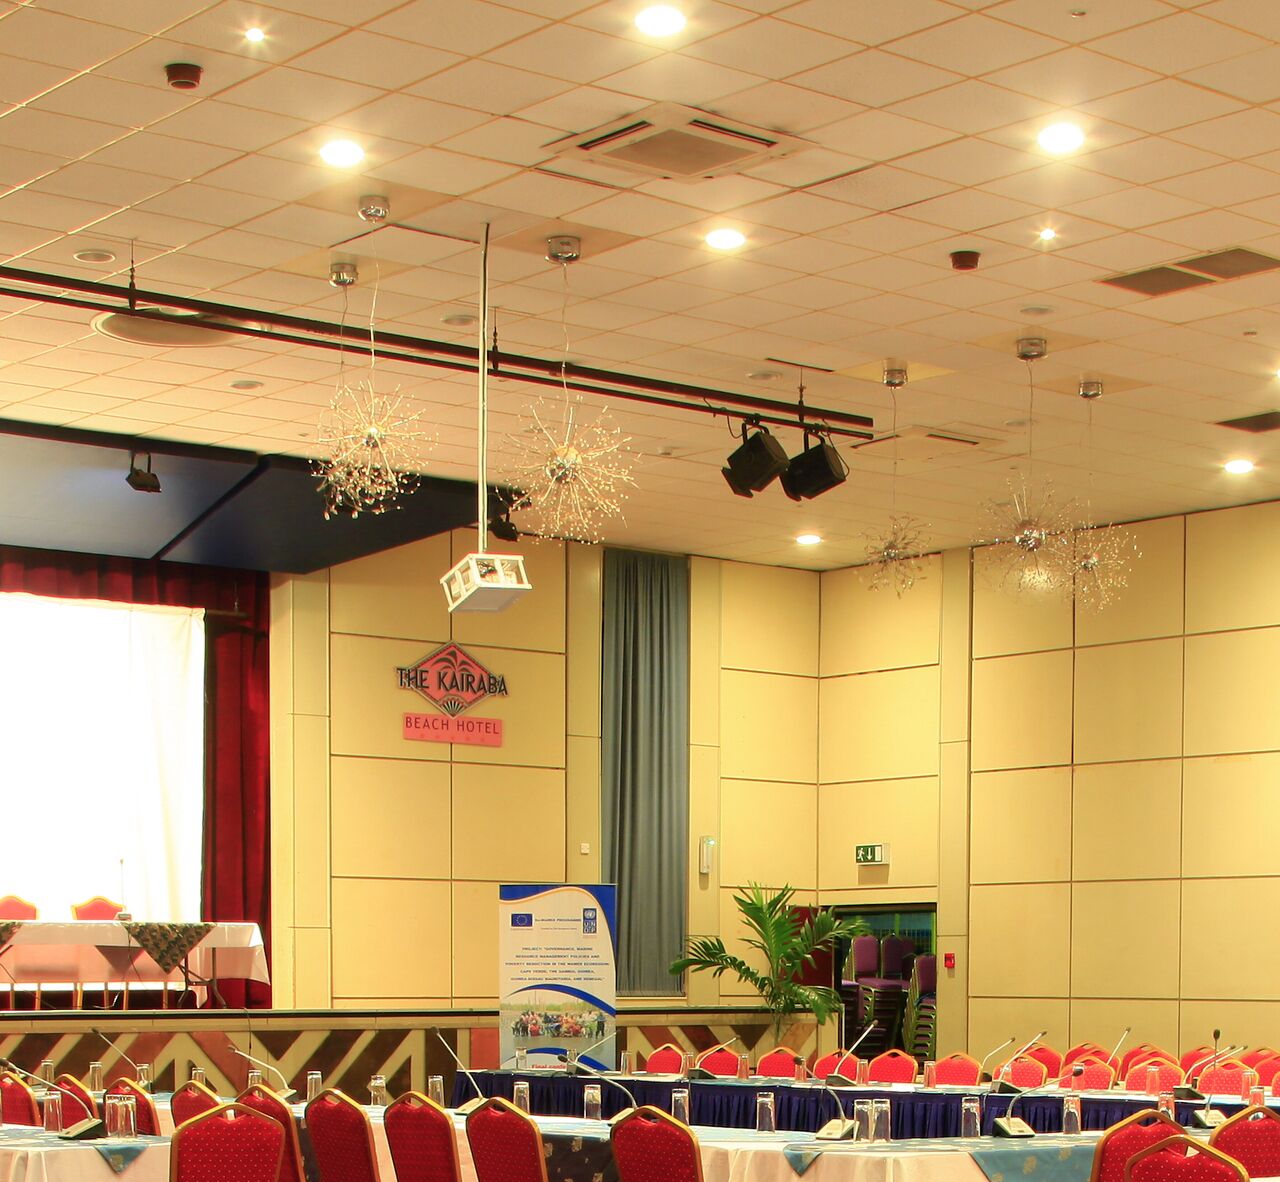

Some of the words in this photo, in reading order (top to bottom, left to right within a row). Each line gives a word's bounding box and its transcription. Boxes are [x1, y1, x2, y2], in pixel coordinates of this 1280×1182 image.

[396, 668, 430, 689] THE
[437, 671, 508, 696] KAIRABA
[405, 716, 450, 731] BEACH
[456, 720, 500, 735] HOTEL
